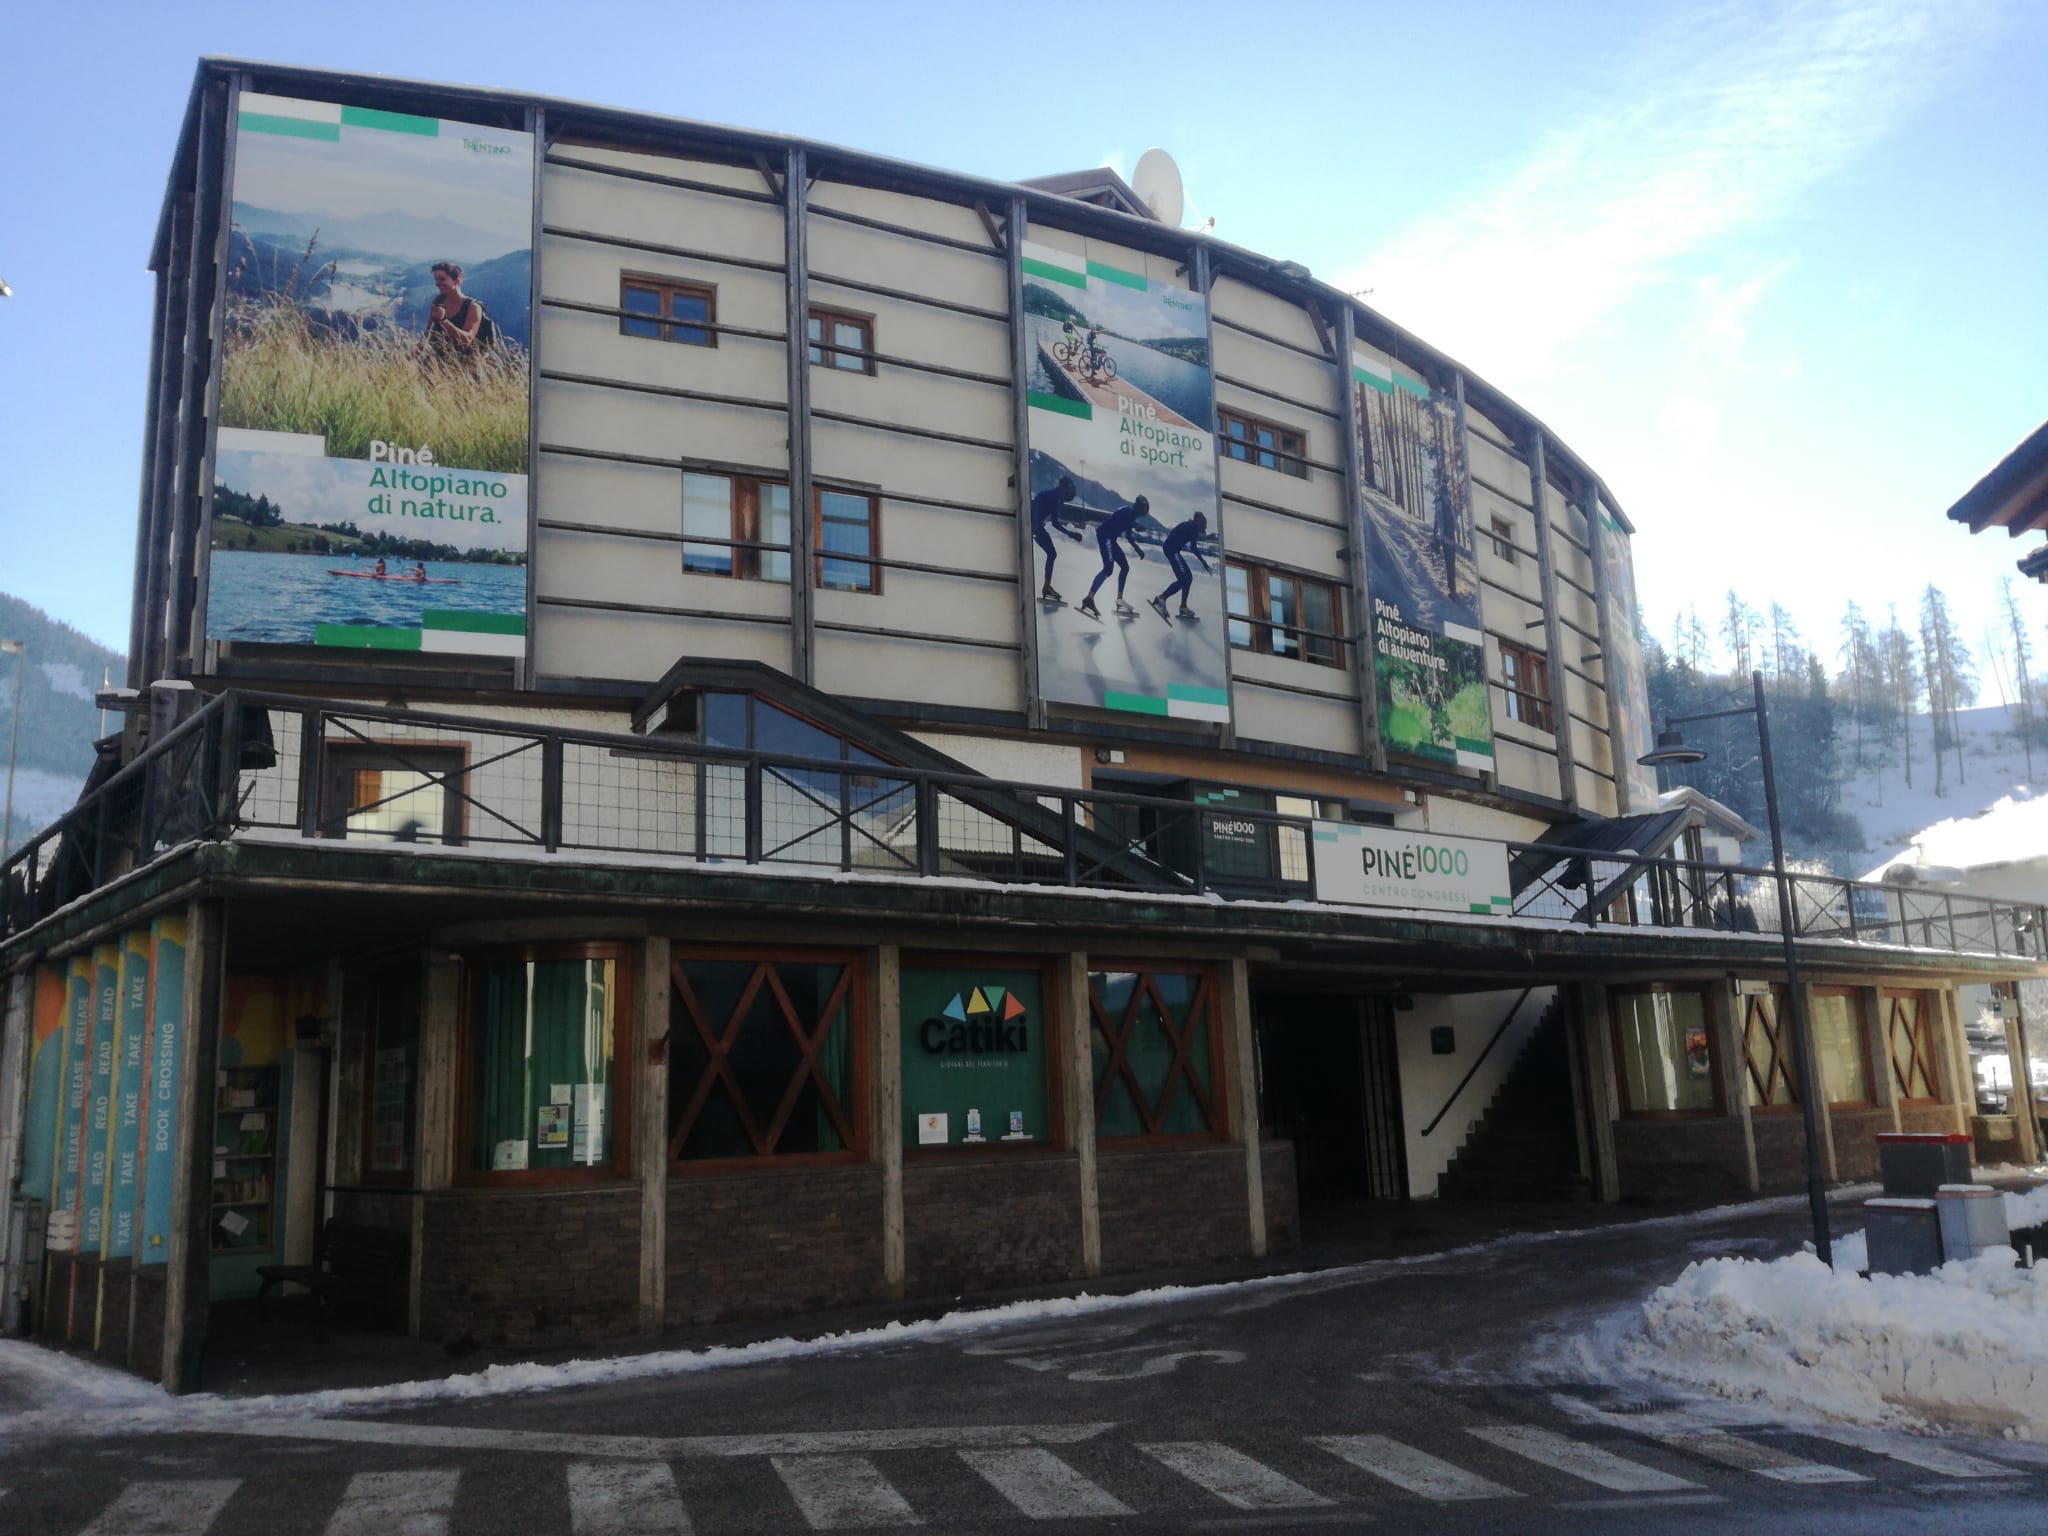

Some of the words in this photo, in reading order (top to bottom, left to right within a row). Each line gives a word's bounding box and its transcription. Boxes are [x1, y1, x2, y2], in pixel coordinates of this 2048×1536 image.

[463, 137, 511, 154] TRENTINO
[1120, 417, 1203, 452] Altopiano
[1120, 439, 1136, 457] di
[1140, 445, 1188, 469] sport.
[368, 466, 508, 500] Altopiano
[368, 494, 393, 515] di
[401, 497, 503, 525] natura.
[1374, 597, 1403, 623] Piné.
[1377, 618, 1430, 649] Altopiano
[1378, 637, 1389, 654] di
[1213, 820, 1255, 835] PINÉ1000
[1362, 843, 1469, 880] PINÉ1000
[1362, 884, 1408, 897] CENTRO
[1411, 888, 1470, 902] CONGRESSI
[102, 986, 115, 1021] READ
[132, 975, 145, 1008] TAKE
[75, 996, 89, 1045] RELEASE
[920, 1015, 1028, 1054] Catiki
[99, 1040, 111, 1075] READ
[128, 1033, 141, 1067] TAKE
[158, 1022, 175, 1099] CROSSING
[72, 1060, 85, 1108] RELEASE
[95, 1095, 108, 1130] READ
[124, 1092, 138, 1127] TAKE
[156, 1108, 169, 1152] BOOK
[67, 1124, 81, 1172] RELEASE
[92, 1151, 104, 1185] READ
[121, 1150, 134, 1185] TAKE
[89, 1206, 101, 1241] READ
[118, 1210, 131, 1246] TAKE
